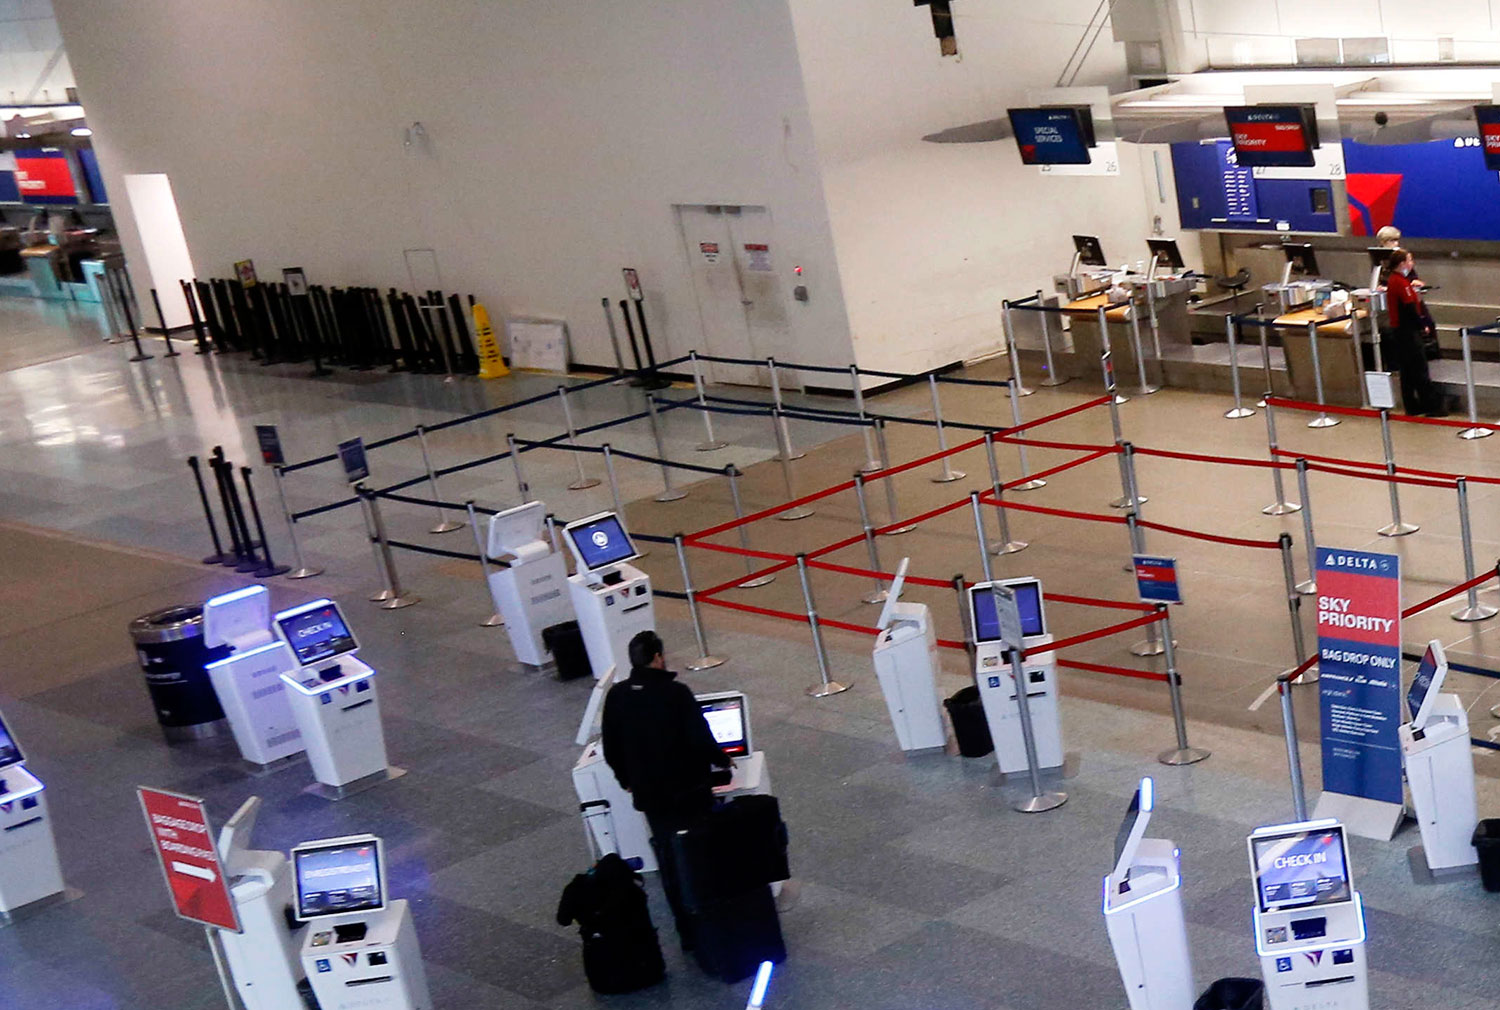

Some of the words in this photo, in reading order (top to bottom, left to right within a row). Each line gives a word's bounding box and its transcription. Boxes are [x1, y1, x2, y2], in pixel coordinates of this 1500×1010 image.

[1337, 555, 1378, 570] DELTA
[1318, 596, 1351, 613] SKY
[1318, 611, 1394, 633] PRIORITY
[1321, 649, 1342, 661] BAG
[1342, 651, 1370, 665] DROP
[1369, 655, 1397, 669] ONLY
[1274, 854, 1314, 869] CHECK
[1313, 851, 1327, 864] IN
